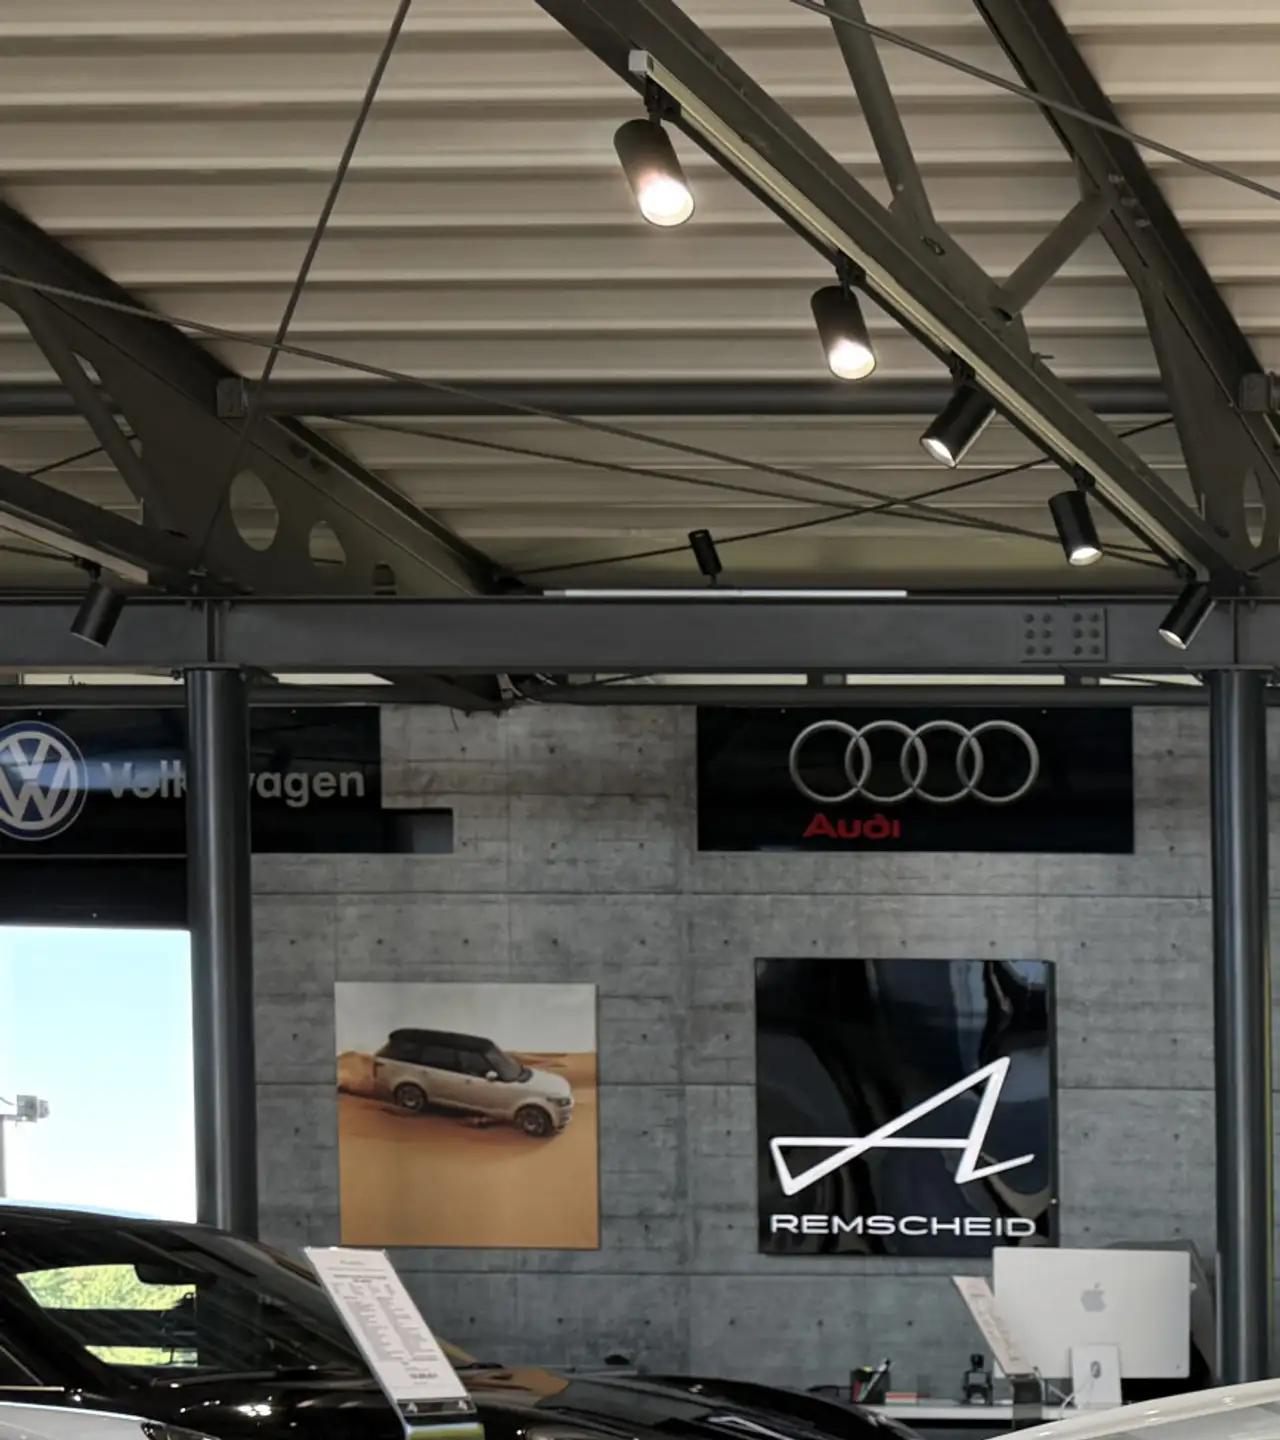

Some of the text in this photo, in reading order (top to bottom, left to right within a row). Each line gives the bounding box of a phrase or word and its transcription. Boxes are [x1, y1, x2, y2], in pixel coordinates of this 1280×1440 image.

[102, 759, 366, 808] Volkagen
[803, 814, 901, 840] Audi
[770, 1213, 1037, 1237] REMSCHEID
